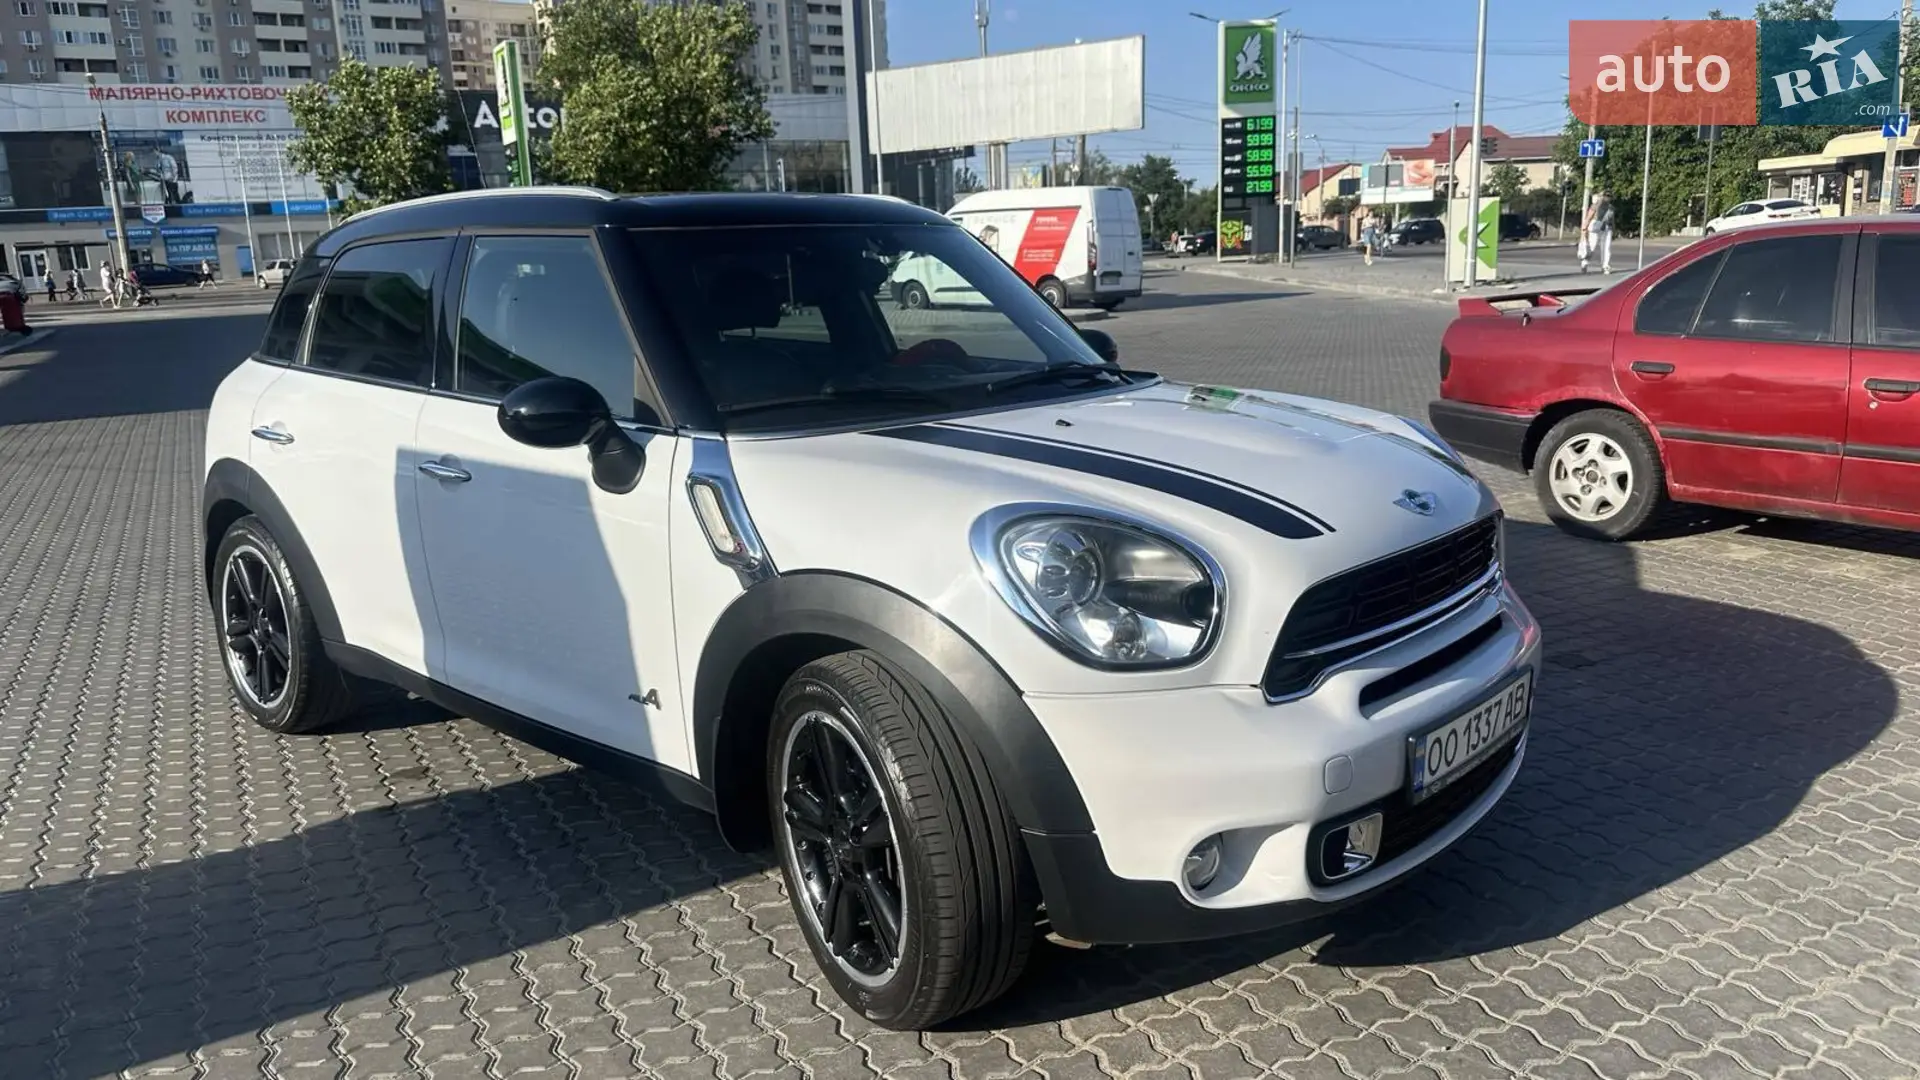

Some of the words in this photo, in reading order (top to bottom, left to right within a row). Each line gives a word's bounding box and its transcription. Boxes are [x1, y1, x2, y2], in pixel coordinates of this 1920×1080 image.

[89, 86, 329, 101] МАЛЯРНО-РИХТОВОЧ
[166, 109, 266, 124] КОМПЛЕКС
[1463, 700, 1502, 755] 1337
[1502, 684, 1525, 729] AB
